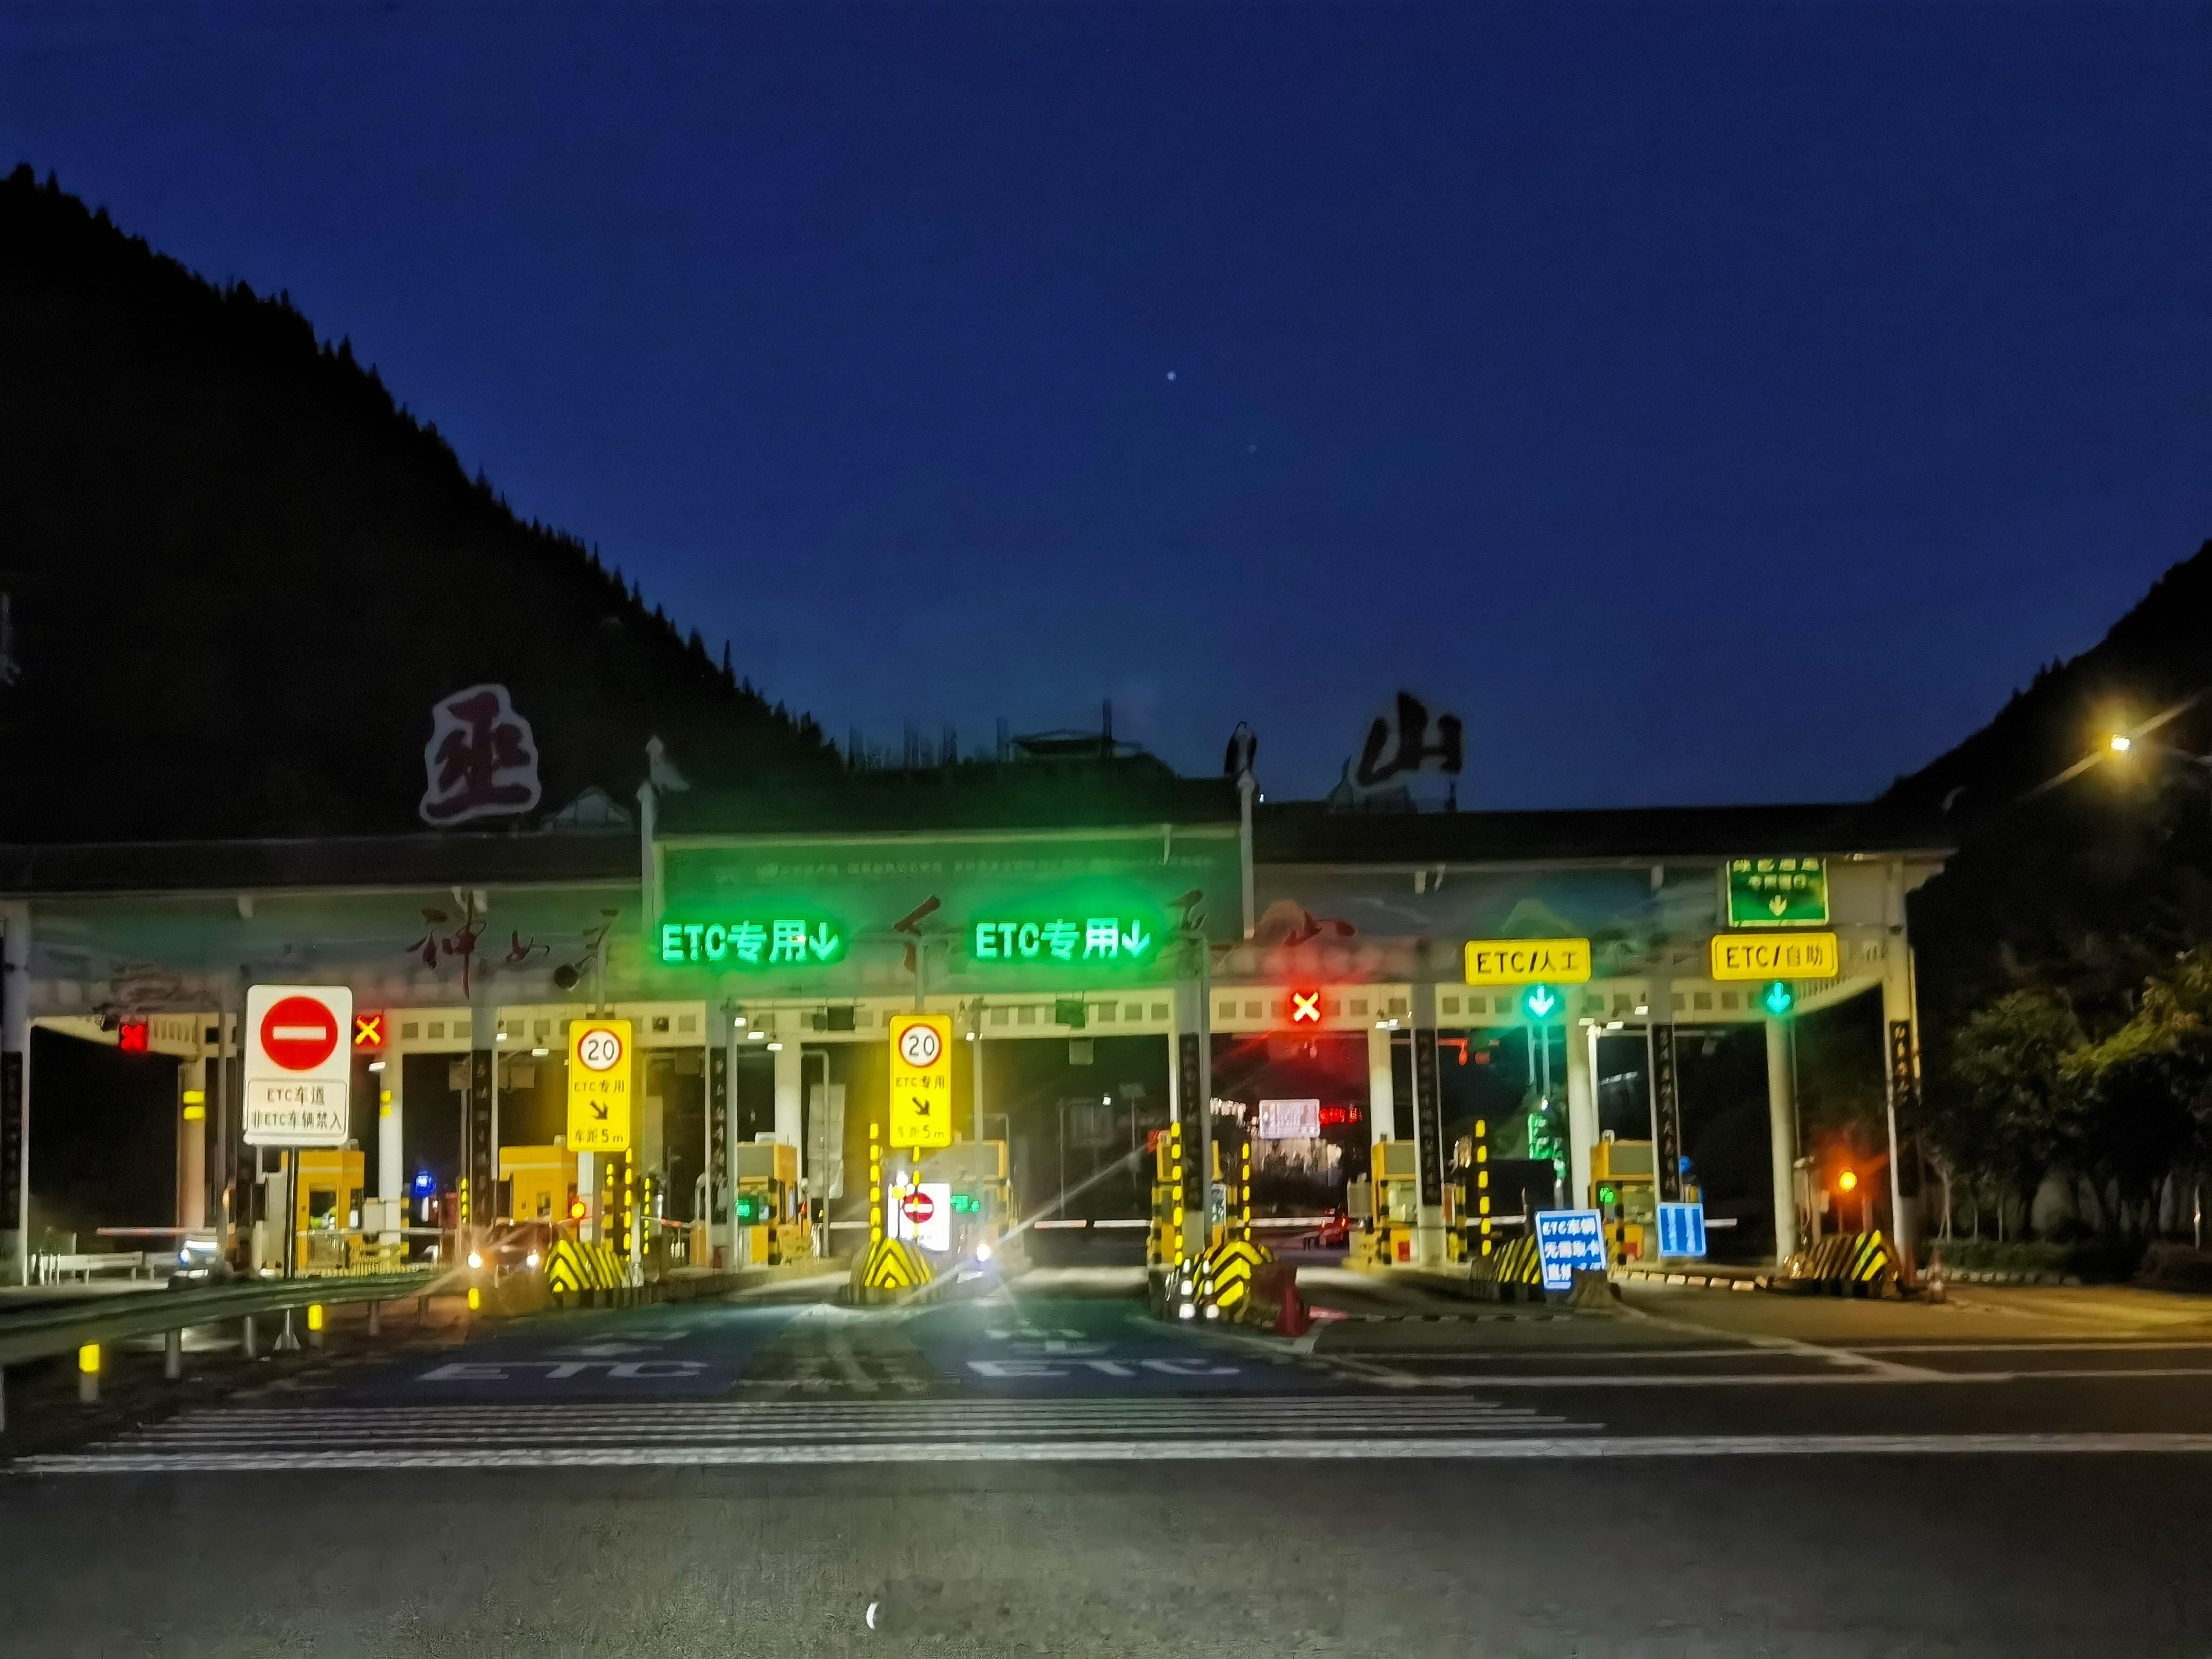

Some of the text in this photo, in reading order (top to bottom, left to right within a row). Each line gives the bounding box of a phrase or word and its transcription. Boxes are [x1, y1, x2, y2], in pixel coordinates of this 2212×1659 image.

[421, 684, 1465, 824] 巫 山
[663, 920, 808, 963] ETC专用
[976, 918, 1120, 960] ETC专用
[1477, 949, 1579, 974] ETC/人工
[1727, 944, 1823, 969] ETC/自助
[588, 1038, 615, 1061] 20
[909, 1034, 935, 1056] 20
[267, 1085, 325, 1106] ETC车道
